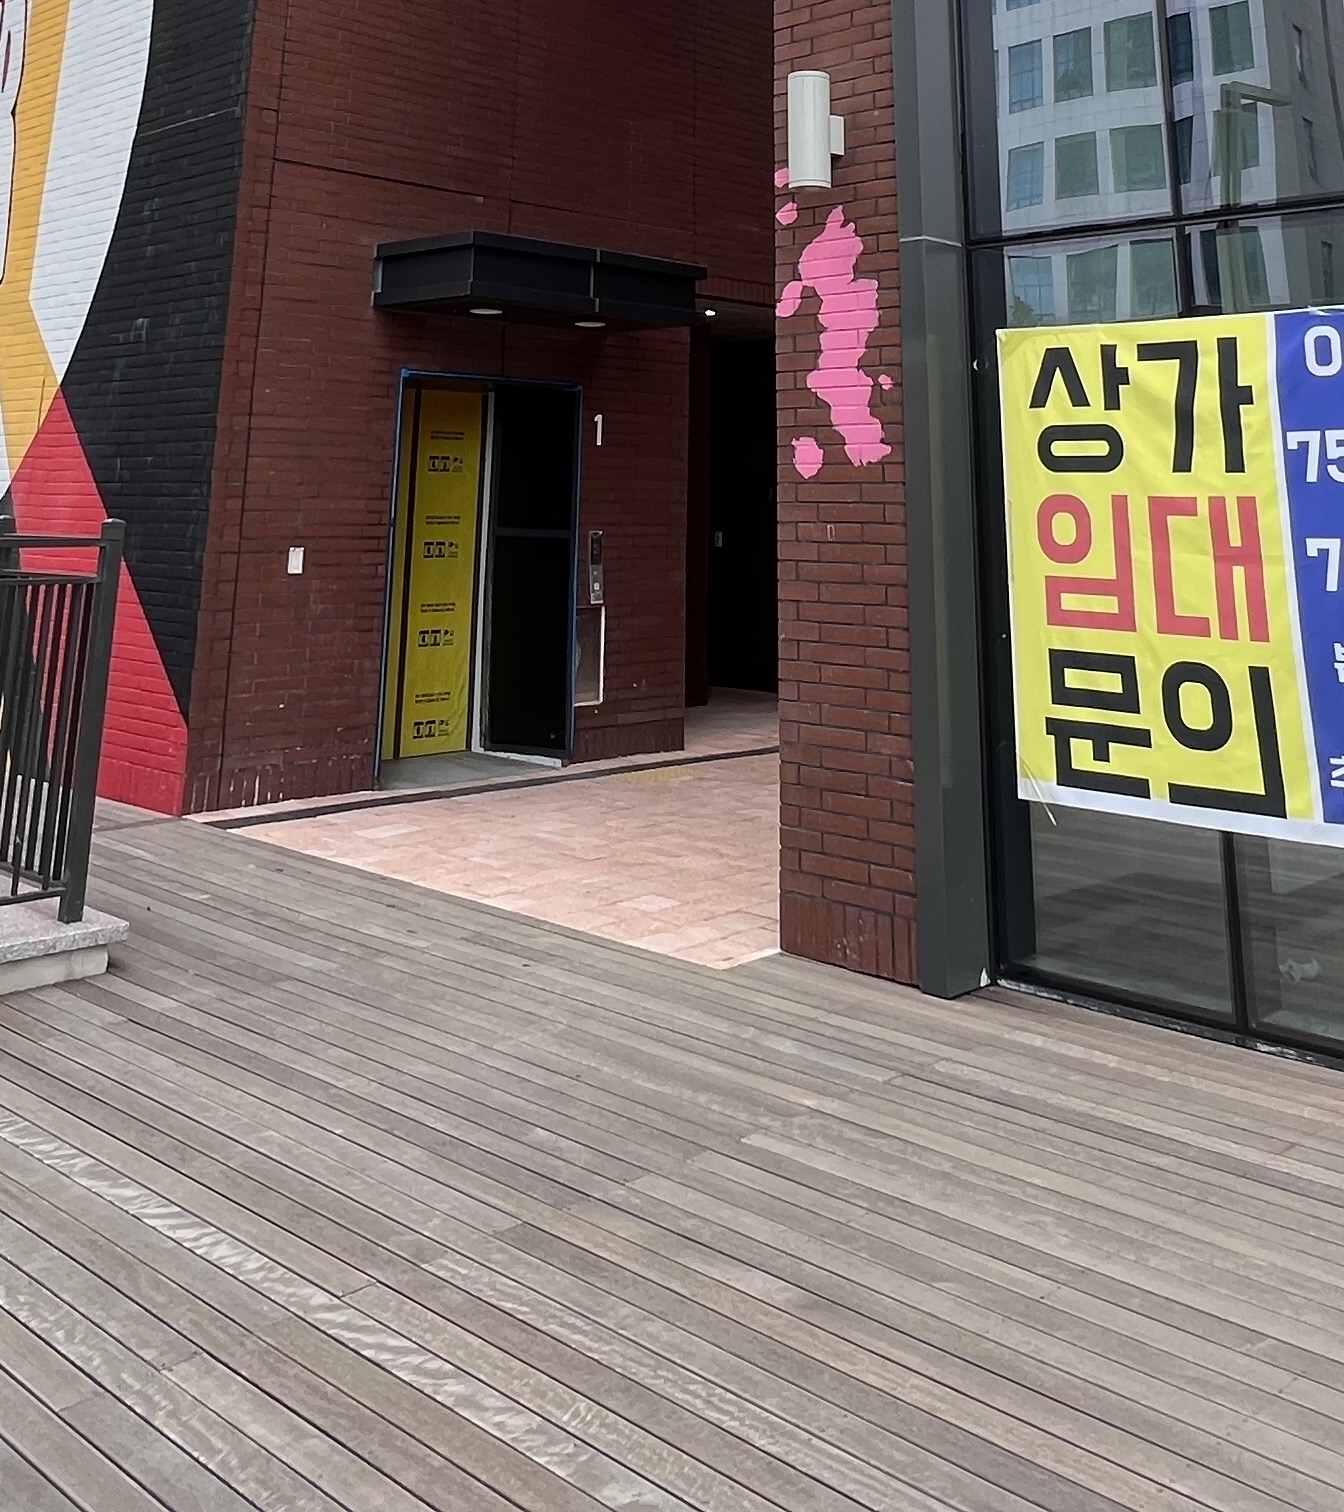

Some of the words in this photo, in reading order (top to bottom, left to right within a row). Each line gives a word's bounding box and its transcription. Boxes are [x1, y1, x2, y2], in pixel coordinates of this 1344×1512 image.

[593, 414, 603, 446] 1
[1029, 337, 1254, 474] 상가
[1037, 493, 1270, 644] 임대
[1045, 648, 1288, 819] 문의
